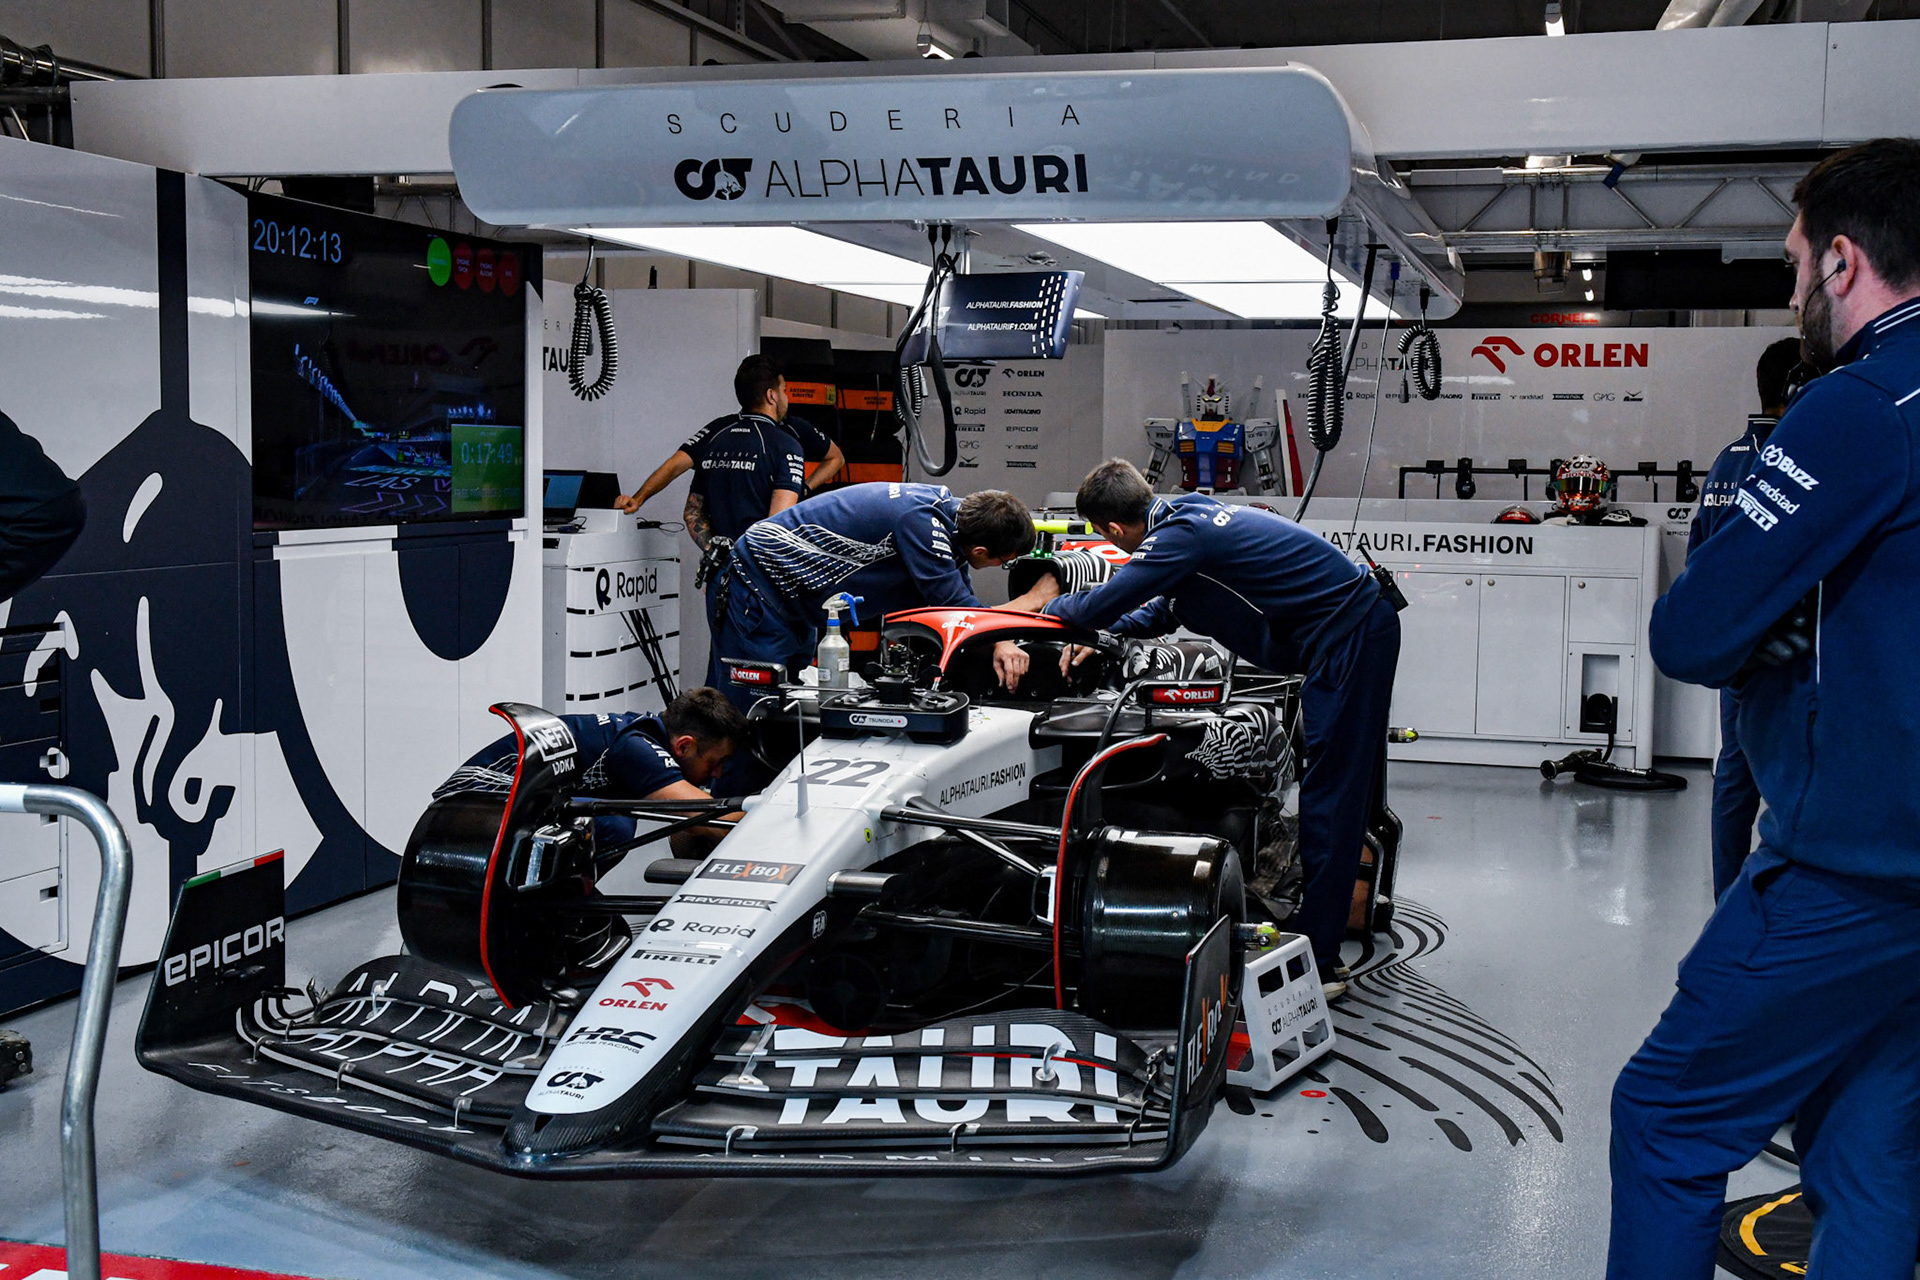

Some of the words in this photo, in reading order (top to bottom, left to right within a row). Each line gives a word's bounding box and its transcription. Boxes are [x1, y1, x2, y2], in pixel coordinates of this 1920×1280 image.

[667, 104, 1080, 134] SCUDERIA
[765, 153, 1089, 199] ALPHATAURI
[253, 218, 342, 263] 20:12:13
[1533, 342, 1649, 368] ORLEN
[1017, 370, 1045, 378] ORLEN
[1002, 390, 1043, 398] HONDA
[964, 406, 986, 415] Rapid
[1322, 531, 1534, 555] ATAURI.FASHION
[616, 567, 658, 603] Rapid
[1182, 689, 1215, 700] ORLEN
[868, 717, 895, 725] TSUNODA
[534, 725, 570, 751] NEFT
[790, 758, 890, 788] 22
[939, 762, 1027, 808] ALPHATAURI.FASHION
[682, 895, 767, 908] RAVENOL
[682, 920, 757, 939] Rapid
[630, 949, 722, 966] PIRELLI
[599, 997, 668, 1012] ORLEN
[565, 1026, 657, 1050] HRC
[774, 1023, 1120, 1125] TAURI
